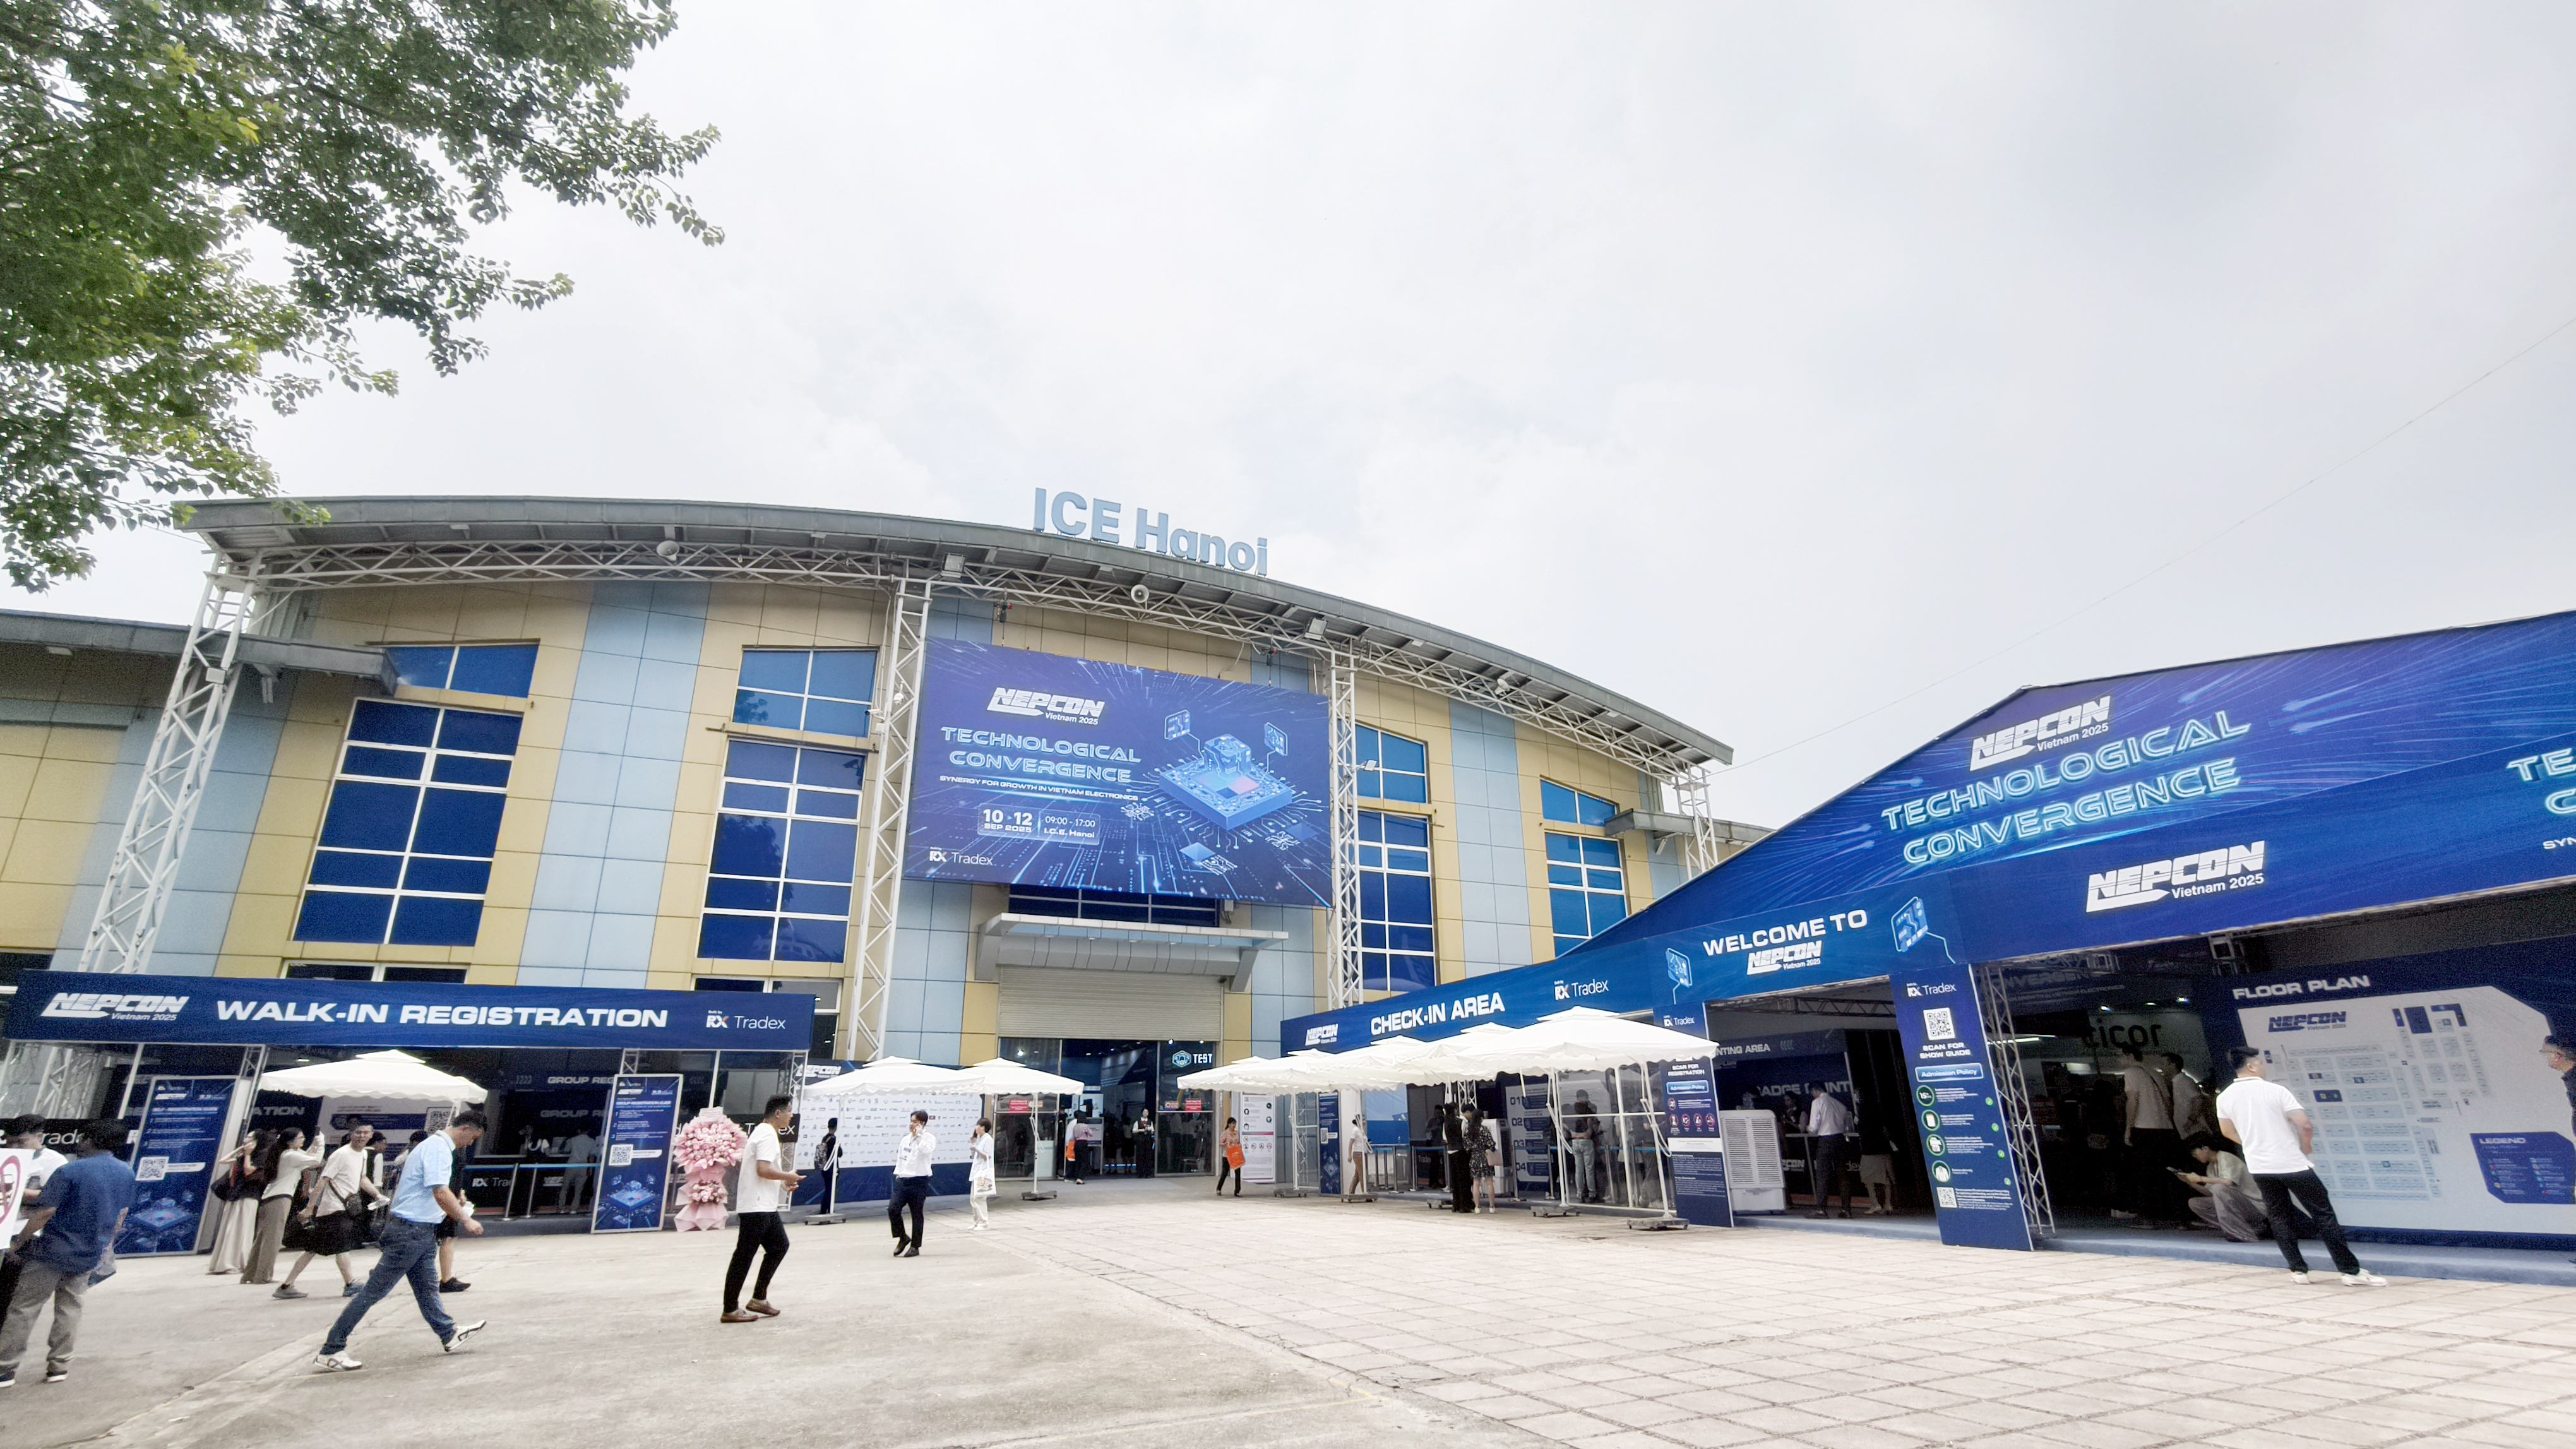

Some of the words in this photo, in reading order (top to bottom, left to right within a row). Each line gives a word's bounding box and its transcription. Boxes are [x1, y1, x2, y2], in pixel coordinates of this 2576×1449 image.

[1034, 487, 1121, 544] ICE
[1136, 508, 1267, 576] Hanoi
[987, 687, 1105, 717] NEPCON
[1045, 712, 1076, 722] Vietnam
[1078, 716, 1099, 725] 2025
[941, 727, 1142, 763] TECHNOLOGICAL
[1969, 696, 2111, 771] NEPCON
[2037, 734, 2079, 751] Vietnam
[2082, 722, 2109, 739] 2025
[950, 751, 1131, 783] CONVERGENCE
[1881, 710, 2251, 830] TECHNOLOGICAL
[939, 775, 981, 785] SYNERGY
[1000, 782, 1037, 790] GROWTH
[1047, 786, 1085, 796] VIETNAM
[1085, 790, 1138, 801] ELECTRONICS
[983, 809, 1003, 823] 10
[1014, 812, 1032, 826] 12
[1045, 816, 1068, 825] 09:00
[1075, 818, 1095, 827] 17:00
[1904, 758, 2241, 863] CONVERGENCE
[951, 852, 993, 866] Tradex
[2086, 840, 2265, 912] NEPCON
[2171, 883, 2226, 898] Vietnam
[2229, 873, 2264, 889] 2025
[1703, 918, 1826, 956] WELCOME
[1829, 909, 1868, 932] TO
[1746, 940, 1822, 975] NEPCON
[1783, 962, 1806, 970] Vietnam
[1571, 979, 1609, 997] Tradex
[1923, 982, 1957, 995] Tradex
[2232, 982, 2303, 999] FLOOR
[2308, 975, 2370, 992] PLAN
[40, 993, 189, 1018] NEPCON
[217, 1000, 389, 1023] WALK-IN
[400, 1005, 668, 1028] REGISTRATION
[1371, 1003, 1446, 1035] CHECK-IN
[1451, 992, 1506, 1020] AREA
[734, 1015, 786, 1029] Tradex
[1674, 1016, 1695, 1025] Tradex
[2268, 1011, 2346, 1032] NEPCON
[1193, 1053, 1212, 1064] TEST
[1716, 1046, 1743, 1056] NTING
[1745, 1044, 1770, 1053] AREA
[1757, 1083, 1801, 1097] ADGE
[540, 1109, 589, 1118] GROUP
